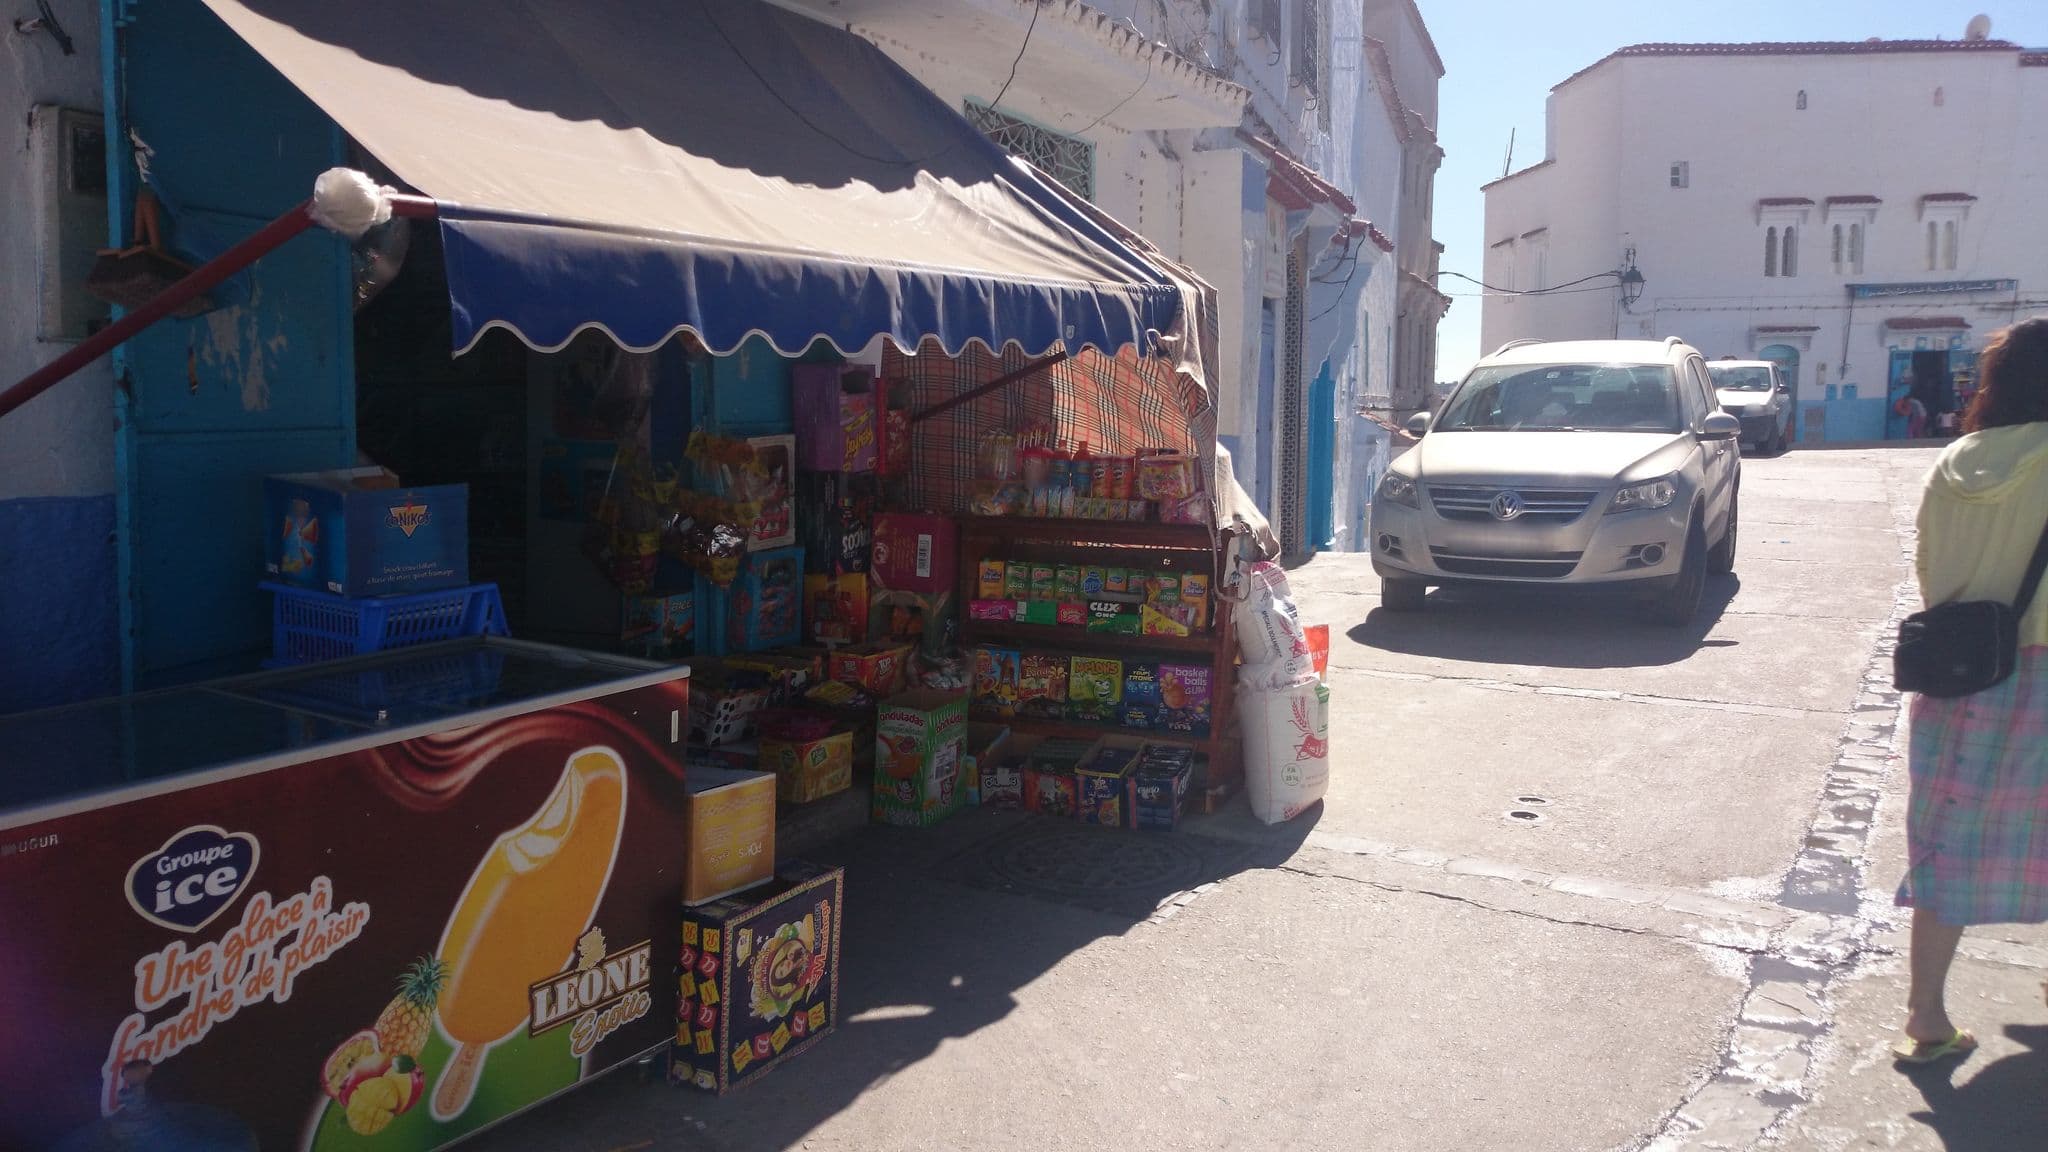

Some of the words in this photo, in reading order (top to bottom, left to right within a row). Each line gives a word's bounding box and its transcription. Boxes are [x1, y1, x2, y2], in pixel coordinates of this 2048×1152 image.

[1089, 601, 1120, 613] CLIX
[1175, 667, 1208, 677] basket
[1184, 677, 1208, 686] balls
[156, 843, 234, 876] Groupe
[154, 866, 239, 914] ice
[141, 945, 214, 1005] Une
[222, 897, 305, 986] glace
[310, 882, 328, 911] à
[243, 950, 275, 997] de
[278, 904, 367, 996] plaisir
[532, 945, 651, 1028] LEONE
[570, 990, 652, 1058] Exotic
